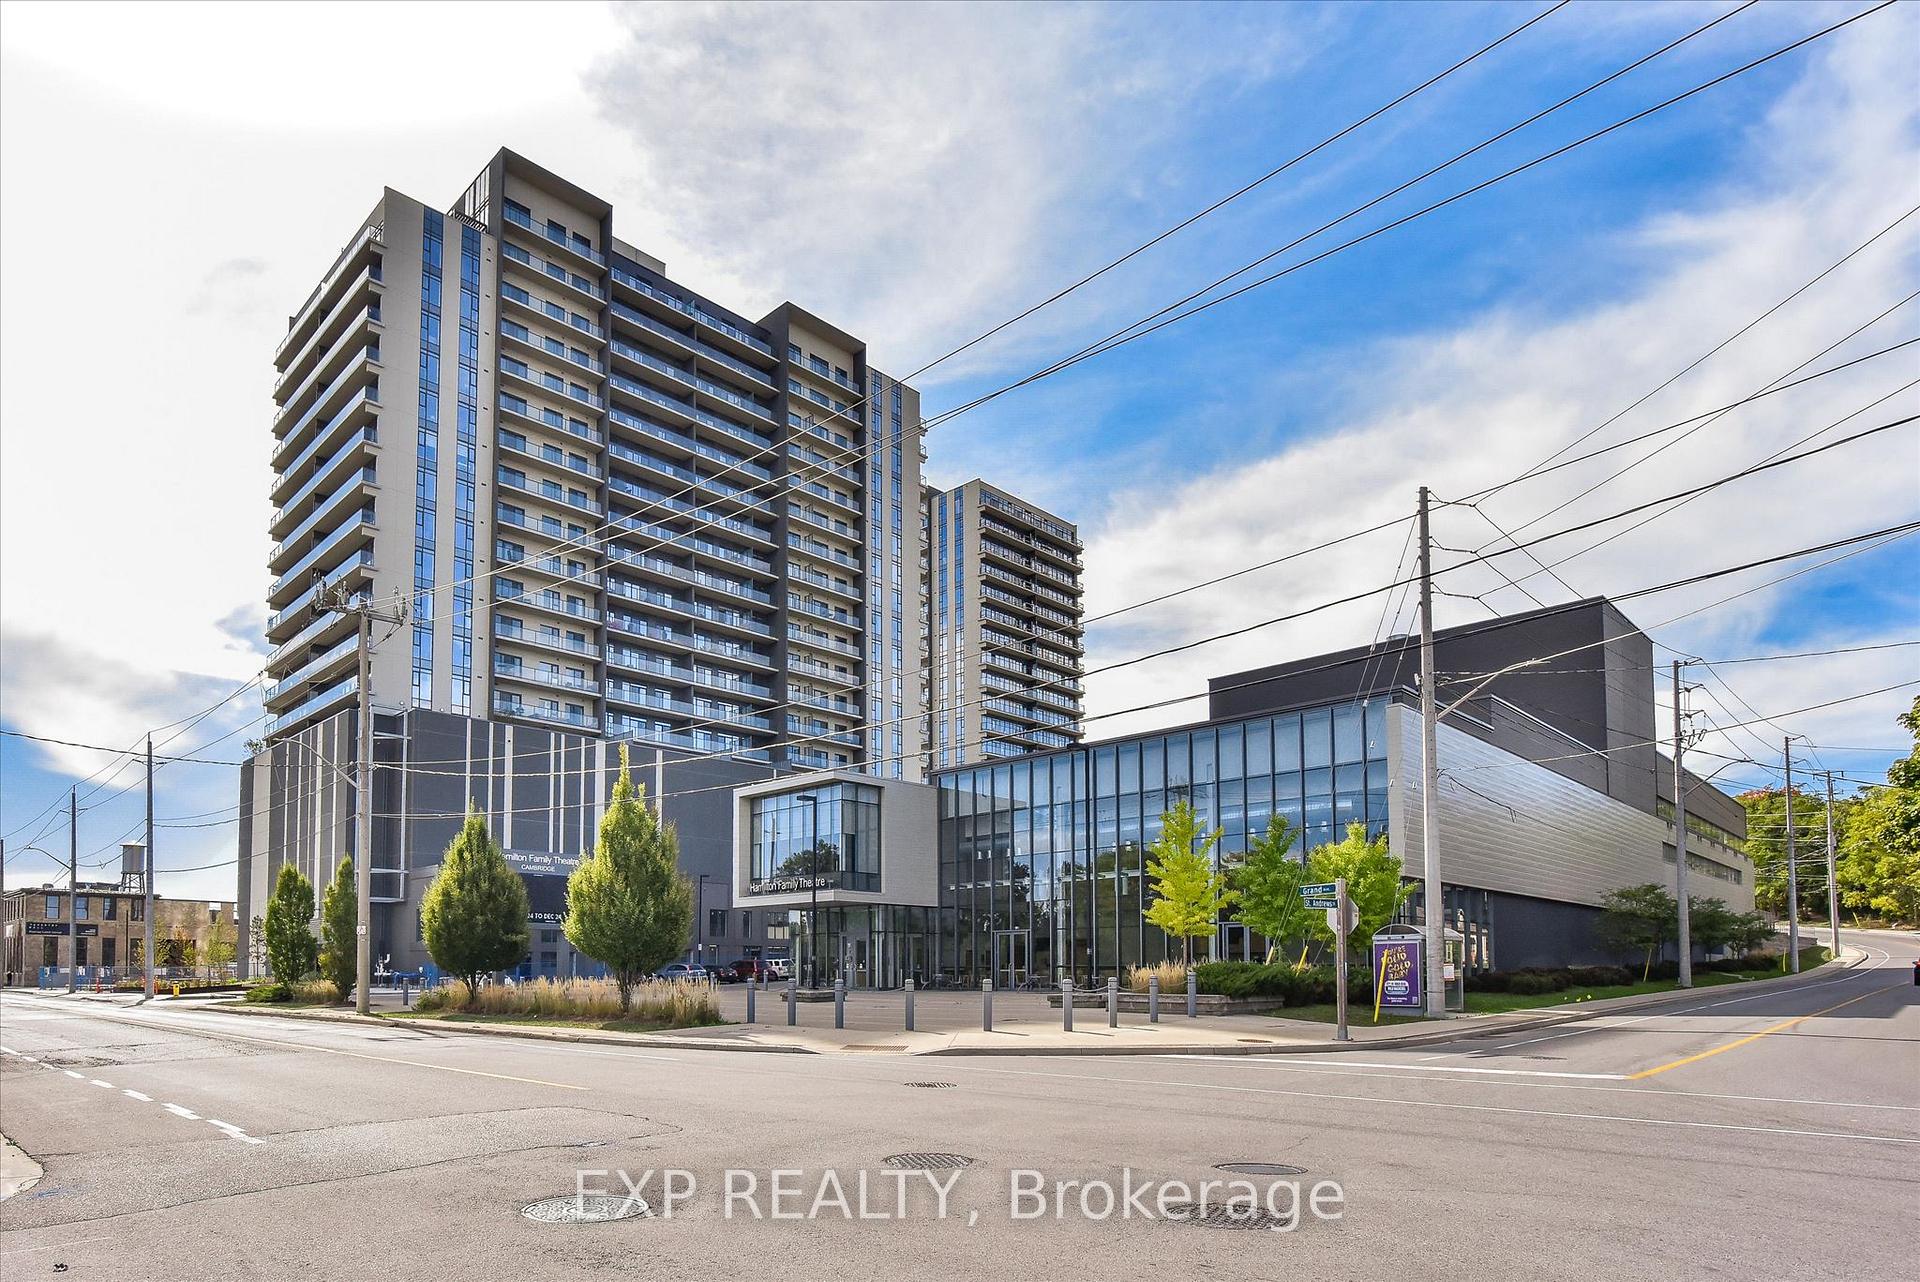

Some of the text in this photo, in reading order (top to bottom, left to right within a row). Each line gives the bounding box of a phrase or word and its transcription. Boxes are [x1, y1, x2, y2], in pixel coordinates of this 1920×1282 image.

[529, 854, 553, 865] Family
[553, 856, 580, 866] Theatre
[521, 863, 555, 872] CAMBRIDGE
[777, 878, 799, 890] Family
[1302, 886, 1323, 895] Grand
